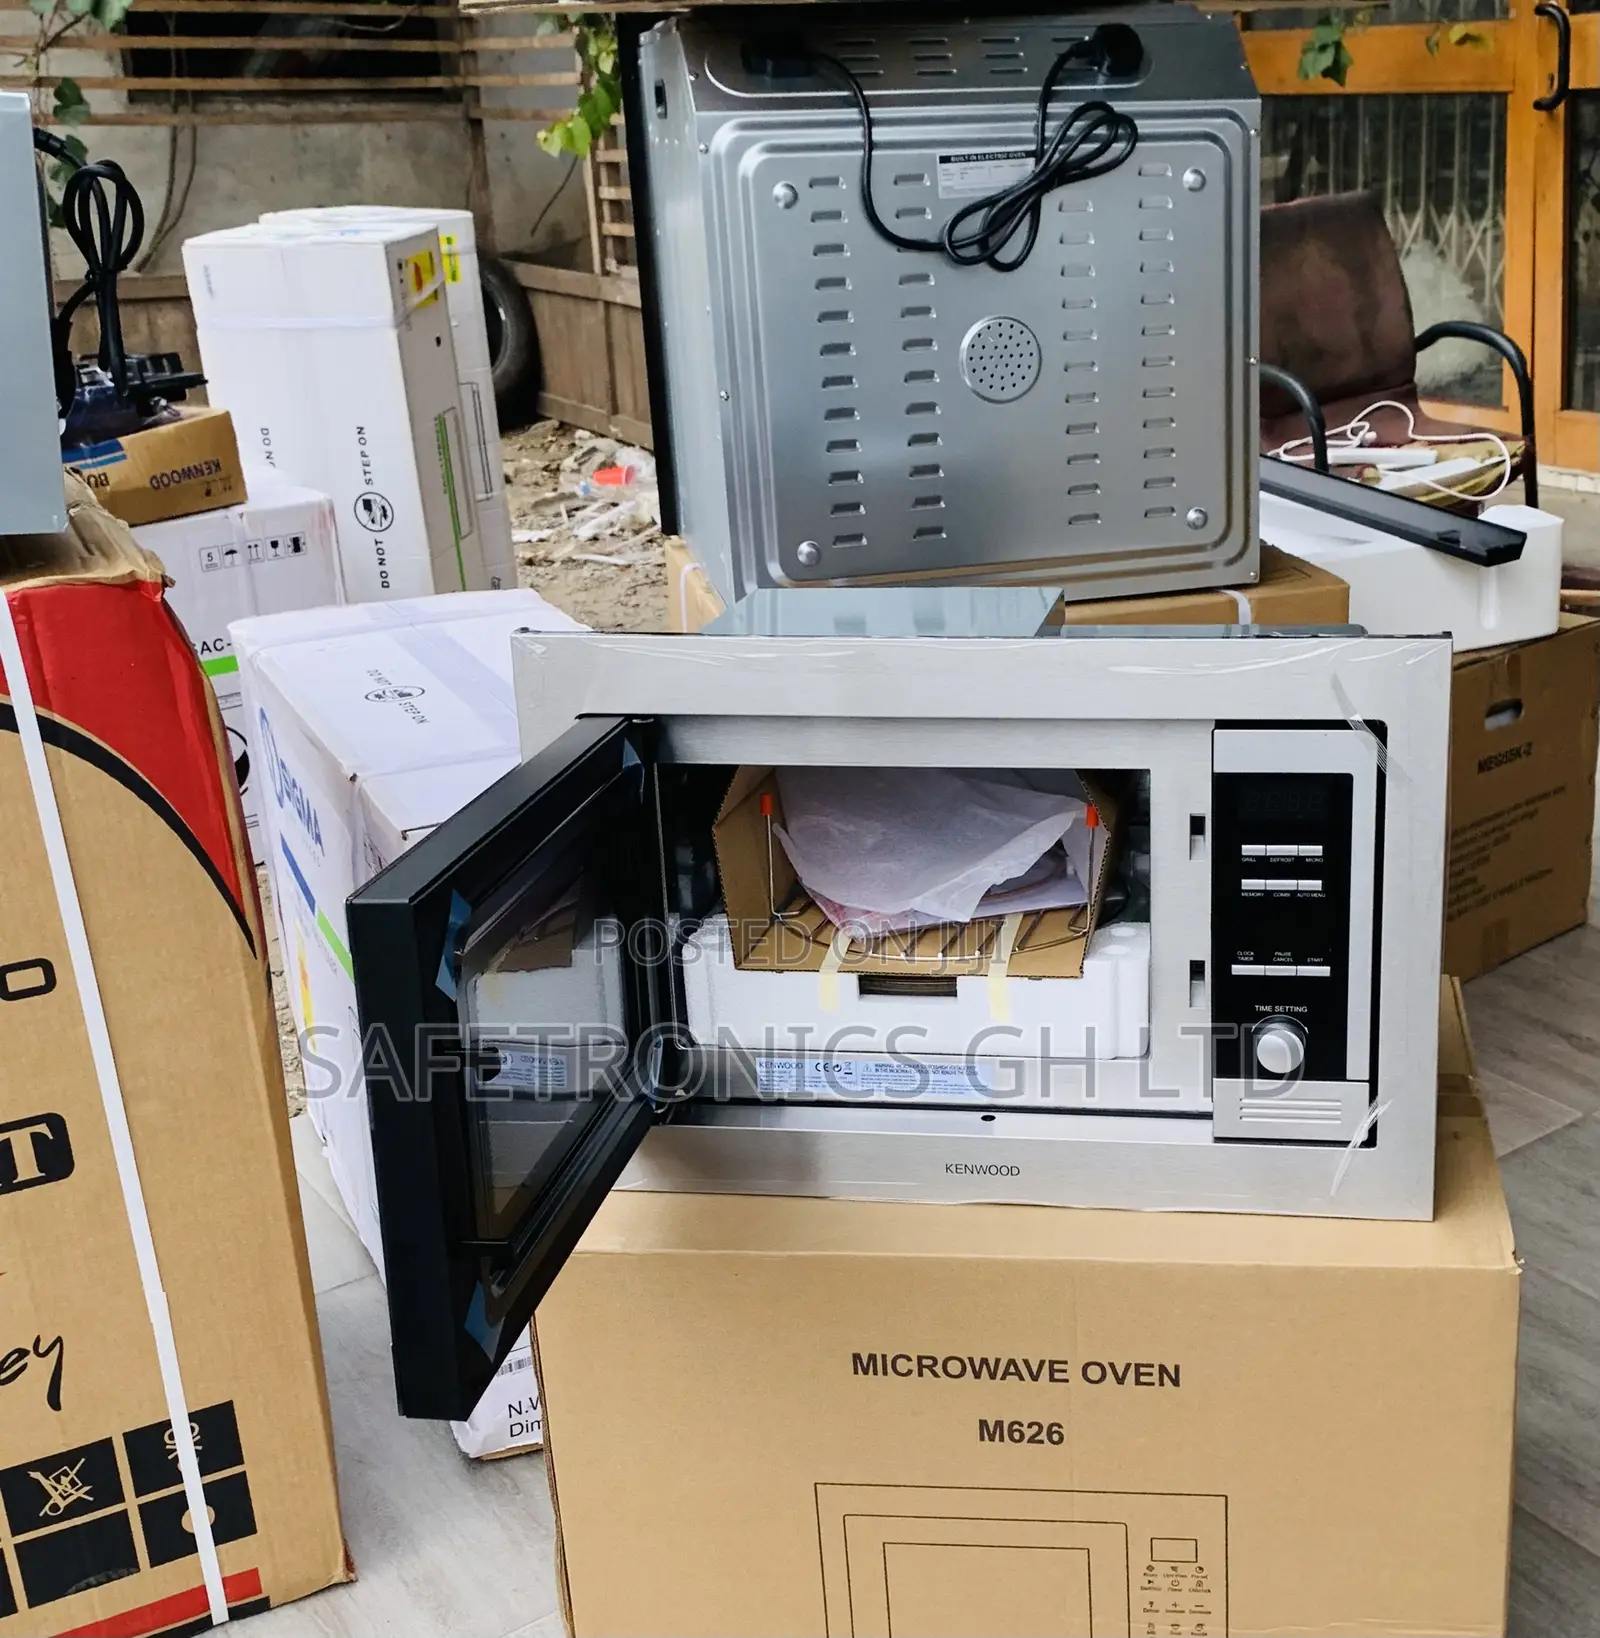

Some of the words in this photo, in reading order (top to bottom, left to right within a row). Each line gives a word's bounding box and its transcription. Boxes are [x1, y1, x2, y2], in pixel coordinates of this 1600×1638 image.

[356, 426, 368, 446] ON
[265, 451, 276, 468] N
[360, 451, 374, 486] STEP
[150, 458, 222, 491] KENWOOD
[374, 538, 387, 566] NOT
[380, 570, 390, 588] DO
[1275, 1005, 1308, 1013] SETTING
[759, 1061, 804, 1070] KENWOOD
[945, 1163, 1020, 1177] KENWOOD
[852, 1352, 1070, 1384] MICROWAVE
[1082, 1361, 1181, 1388] OVEN
[978, 1418, 1065, 1446] M626
